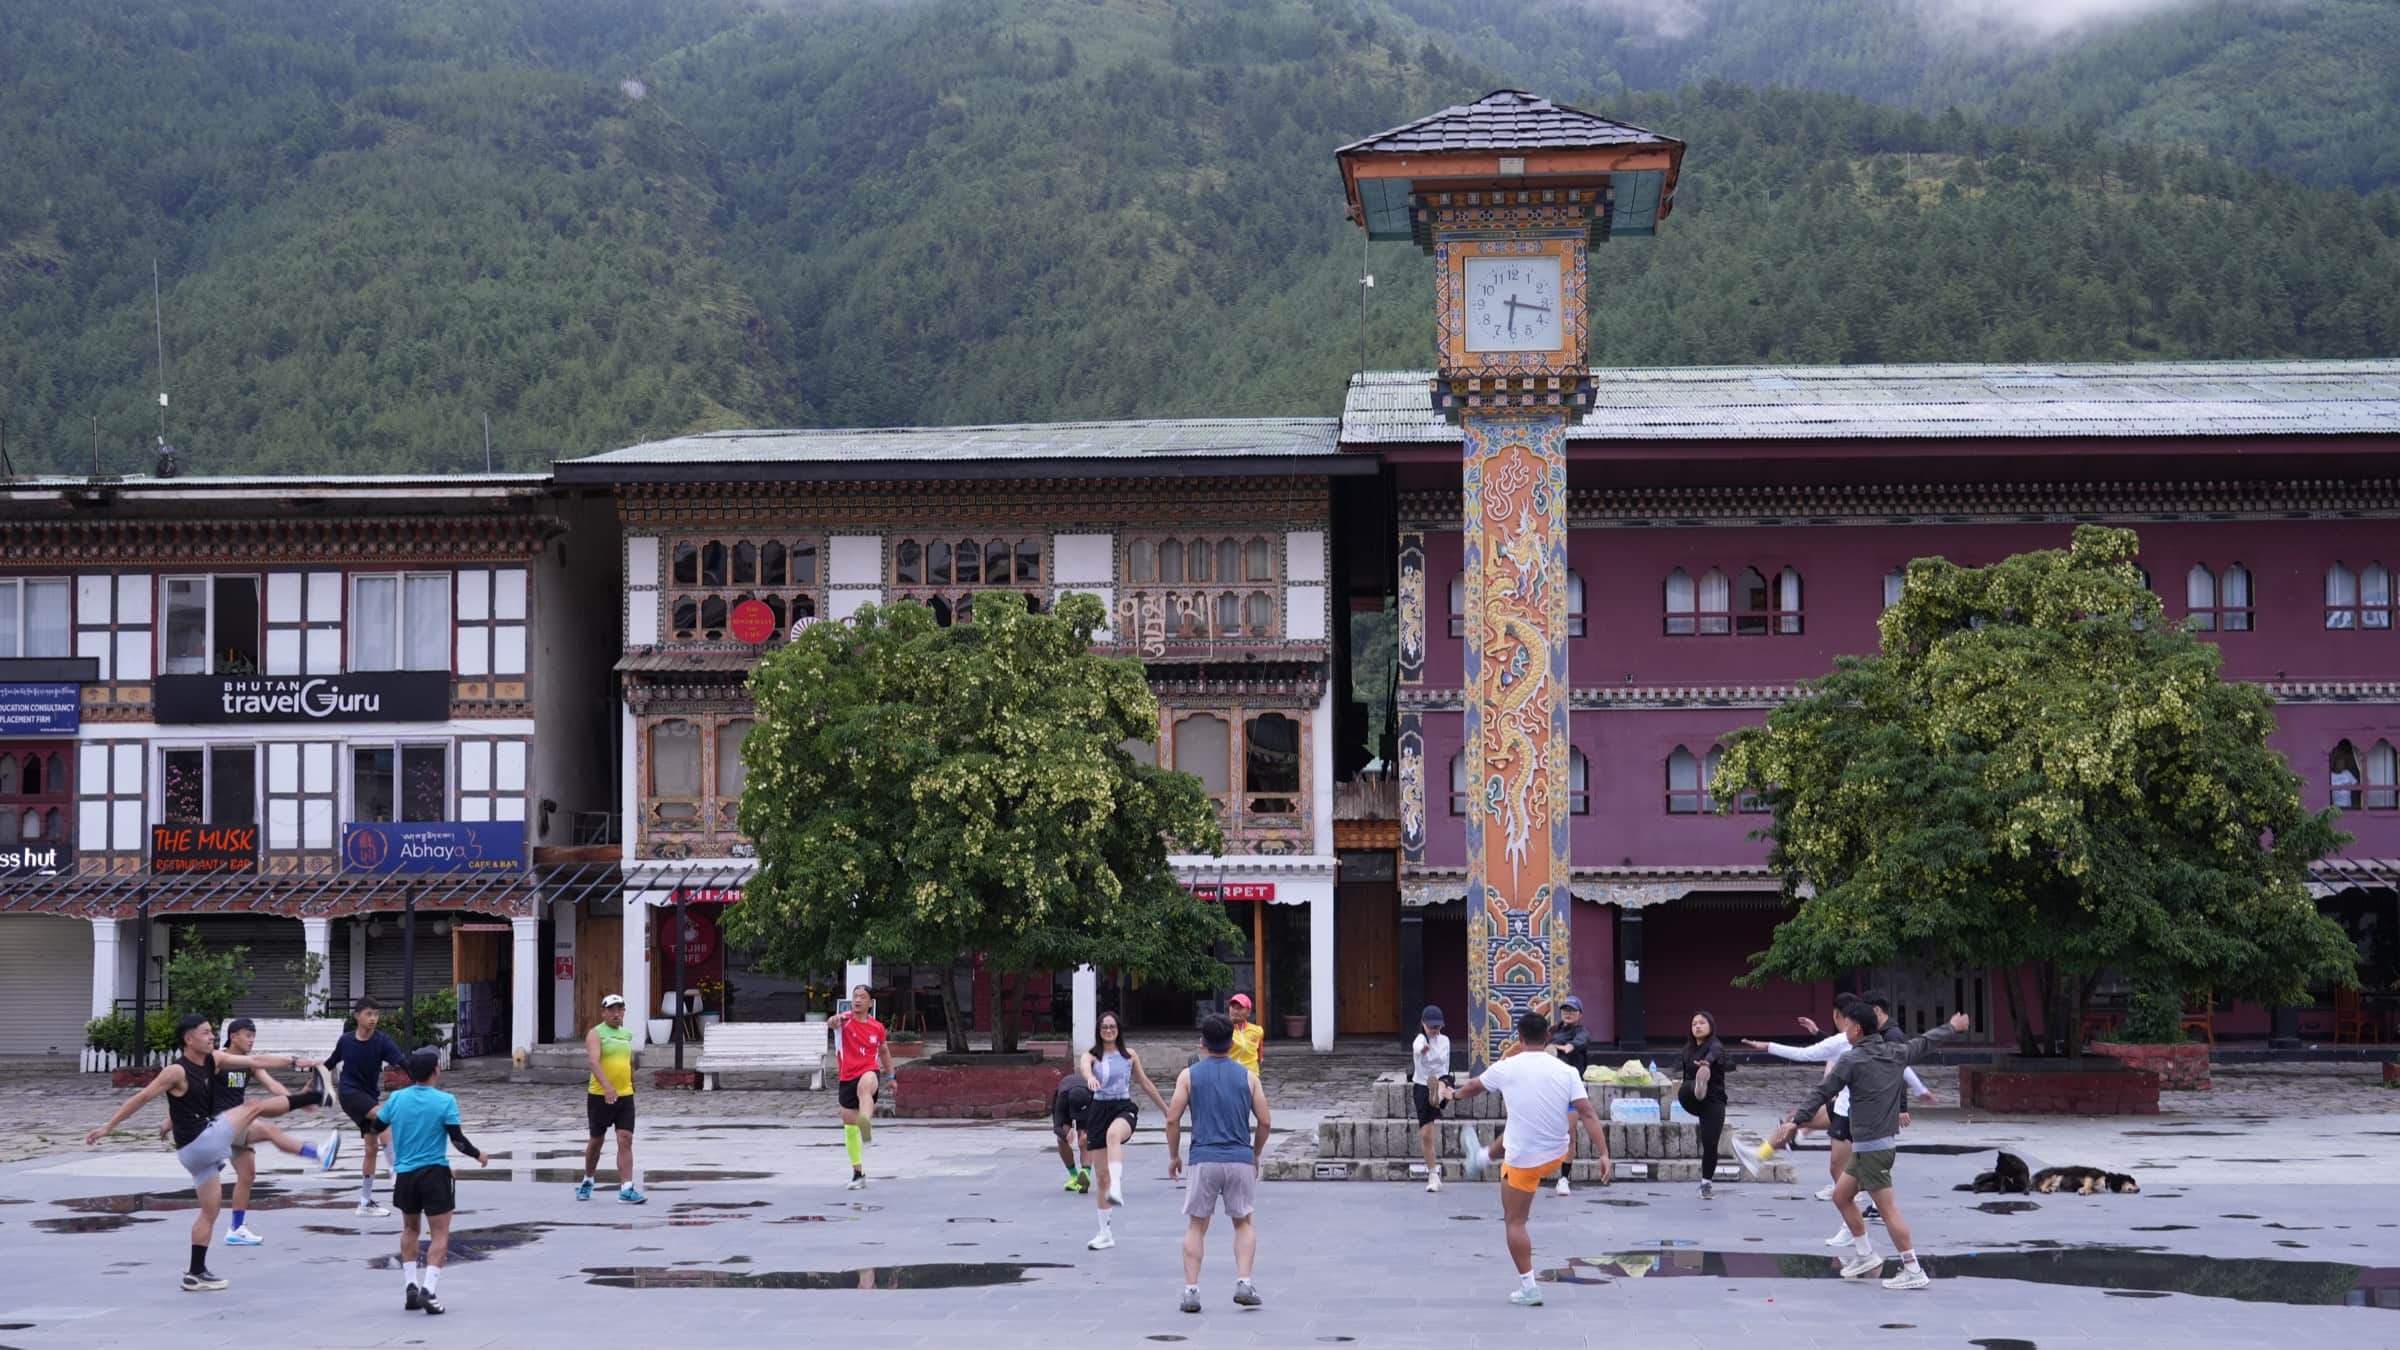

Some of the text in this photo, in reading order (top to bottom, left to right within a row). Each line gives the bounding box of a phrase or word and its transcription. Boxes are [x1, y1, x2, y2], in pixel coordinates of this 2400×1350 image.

[1494, 274, 1503, 285] 11
[1508, 269, 1519, 280] 12
[1483, 285, 1494, 296] 10
[1536, 282, 1543, 294] 2
[1477, 298, 1485, 310] 9
[1483, 313, 1490, 325] 8
[1536, 313, 1544, 324] 4
[1495, 325, 1501, 336] 7
[1509, 328, 1517, 339] 6
[1525, 324, 1533, 336] 5
[224, 681, 300, 691] BHUTAN
[30, 704, 75, 712] CONSULTANCY
[36, 715, 51, 723] FIRM
[154, 827, 255, 853] THE MUSK
[24, 847, 57, 867] hut
[400, 843, 467, 861] Abhaya
[230, 859, 250, 870] BAR
